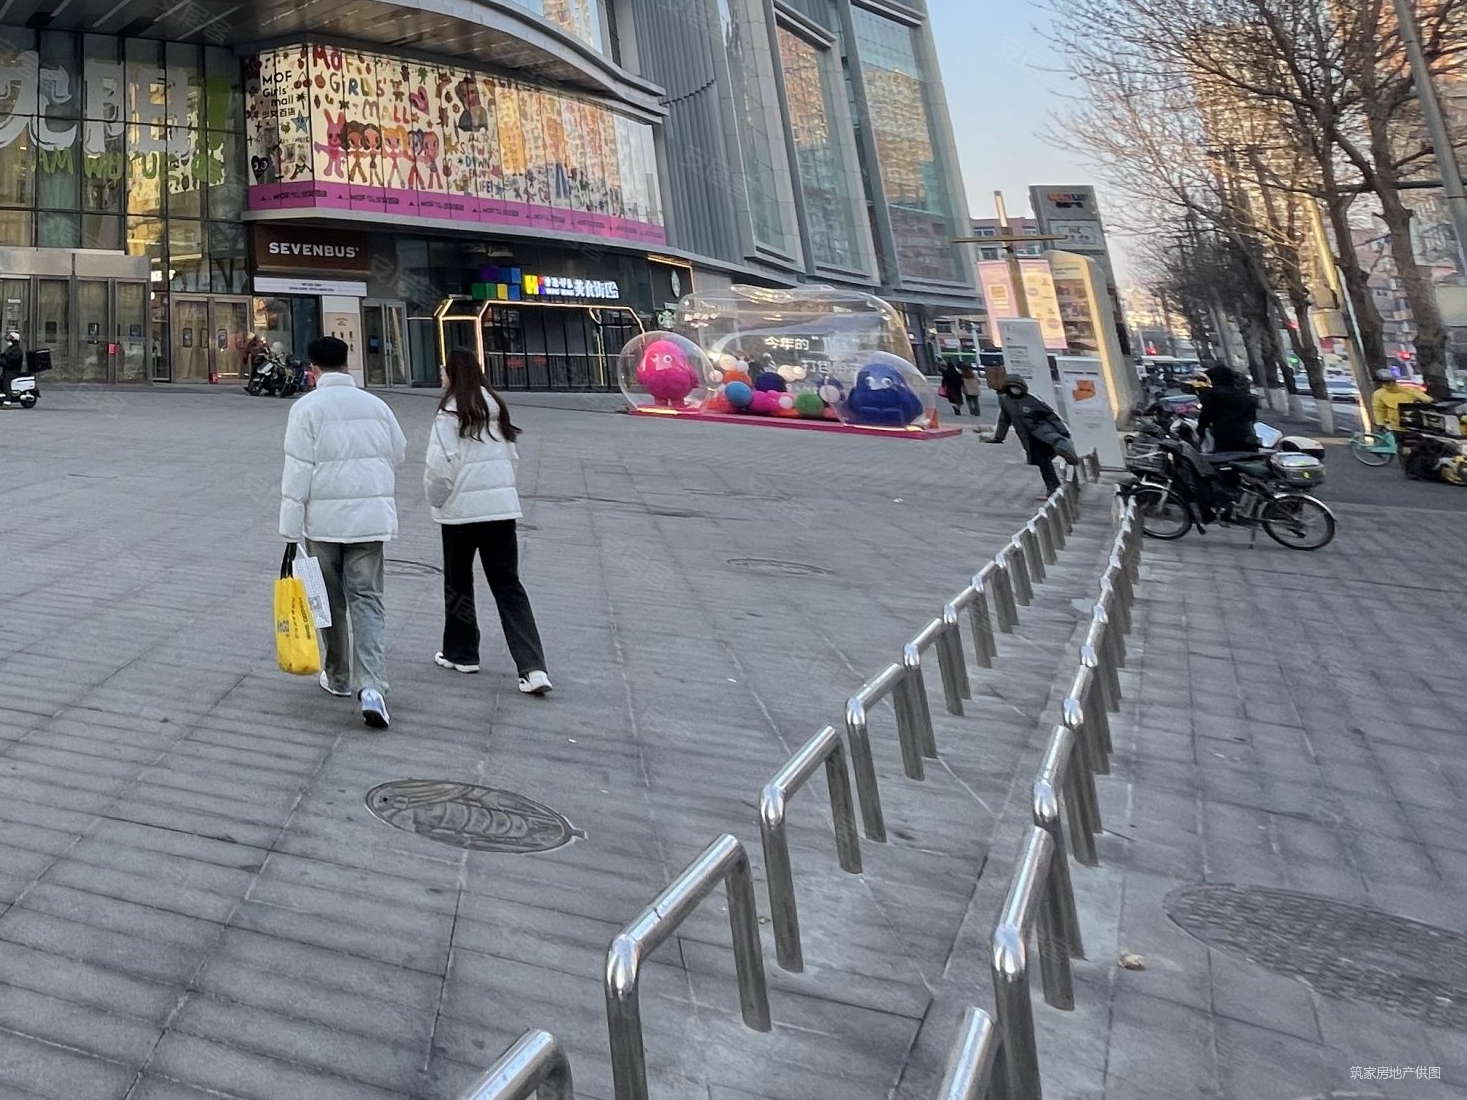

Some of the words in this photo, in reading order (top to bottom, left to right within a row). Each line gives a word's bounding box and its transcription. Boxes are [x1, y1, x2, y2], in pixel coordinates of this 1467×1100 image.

[312, 44, 354, 74] MOF
[262, 70, 292, 86] MOF
[271, 95, 294, 106] mall
